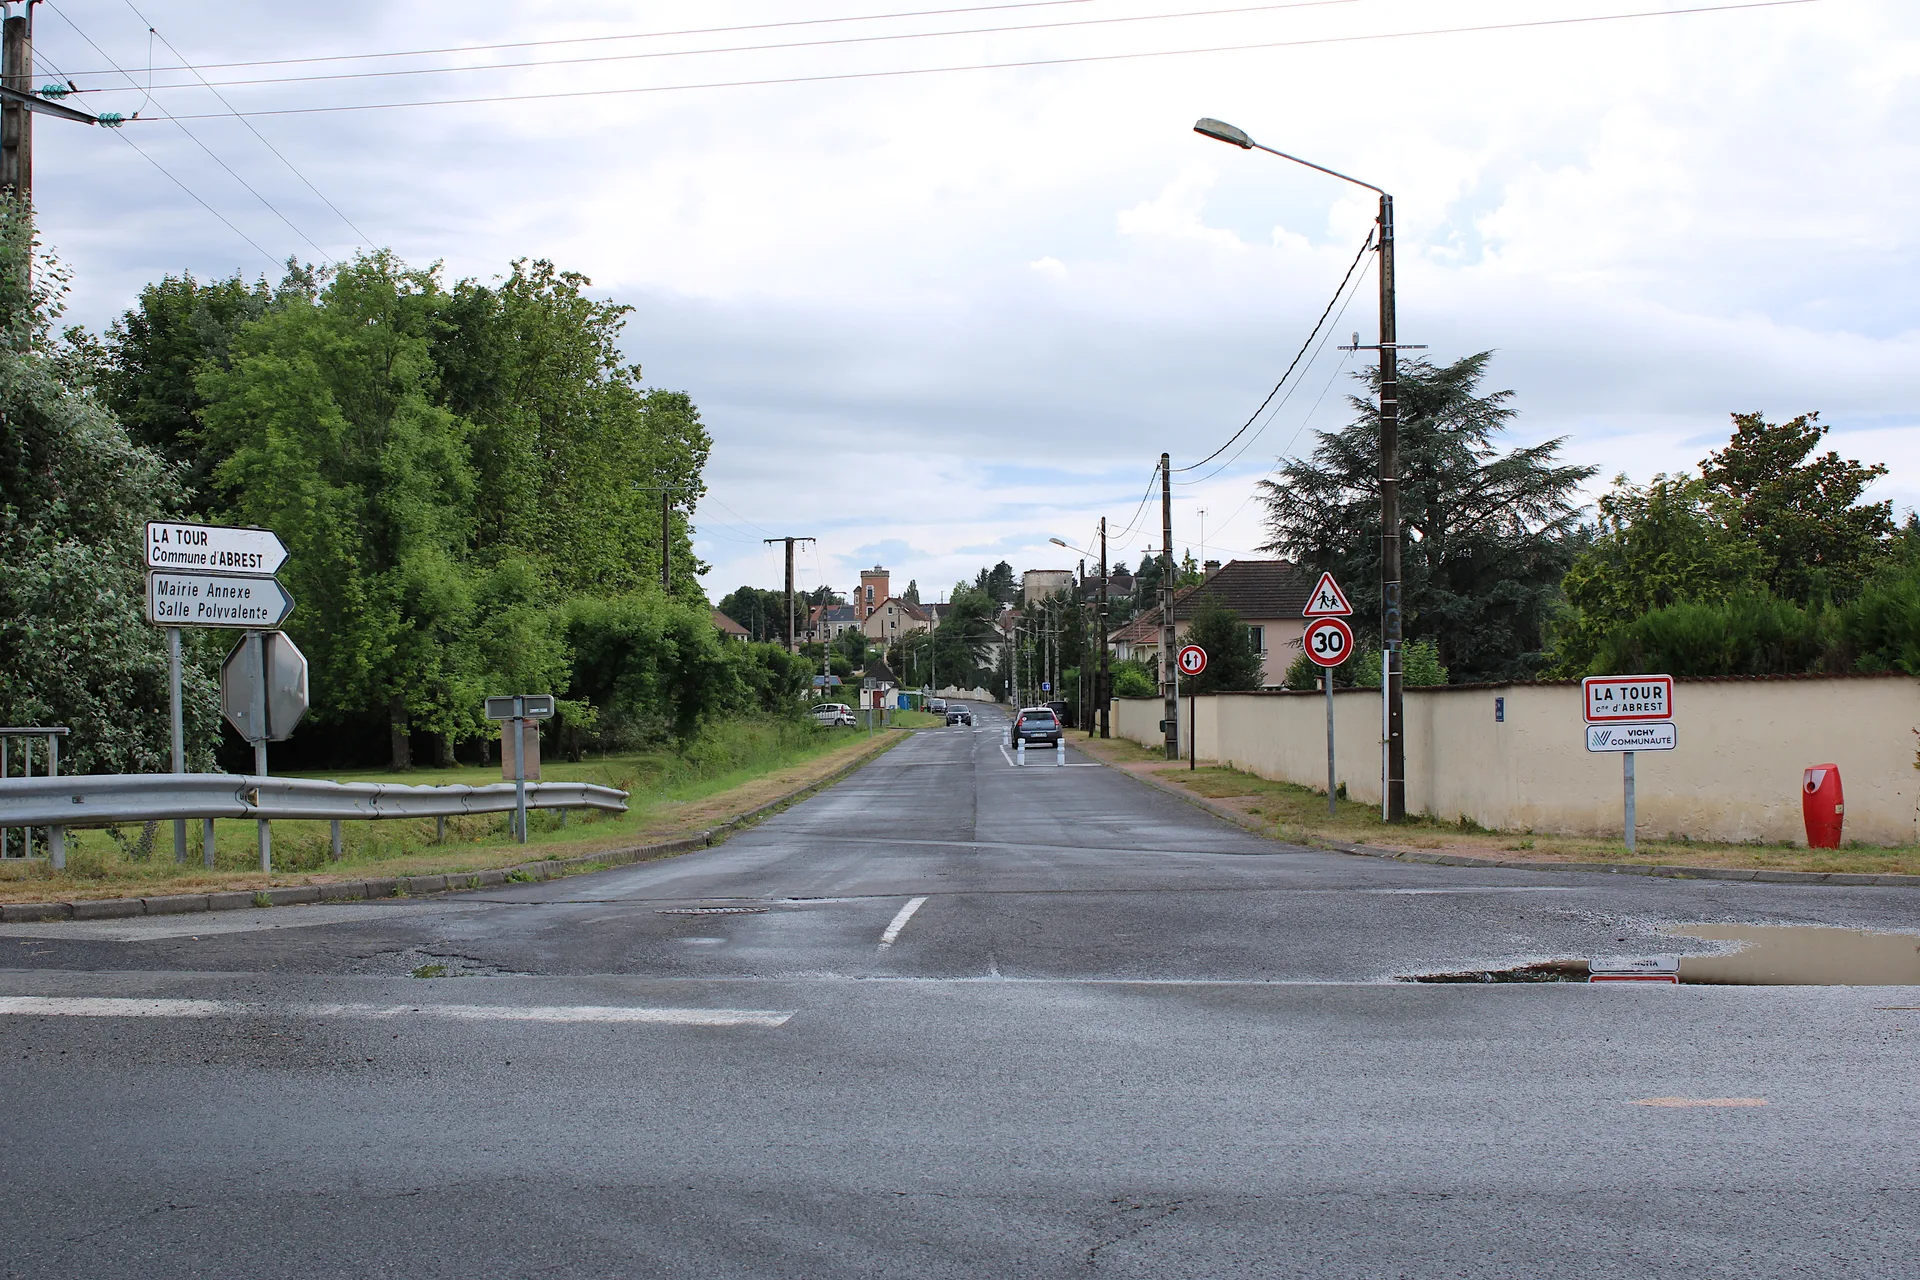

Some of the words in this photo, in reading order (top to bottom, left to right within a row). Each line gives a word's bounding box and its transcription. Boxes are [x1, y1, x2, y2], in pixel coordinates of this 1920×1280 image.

[153, 528, 169, 544] LA
[176, 530, 208, 546] TOUR
[152, 546, 207, 565] Commune
[210, 551, 263, 568] d'ABREST
[158, 580, 199, 597] Mairie
[207, 583, 251, 599] Annexe
[158, 600, 190, 617] Salle
[198, 602, 268, 620] Polyvalente
[1314, 631, 1344, 653] 30
[1594, 688, 1613, 701] LA
[1620, 686, 1662, 700] TOUR
[1612, 702, 1663, 713] d'ABREST
[1611, 736, 1672, 746] COMMUNAUTÉ
